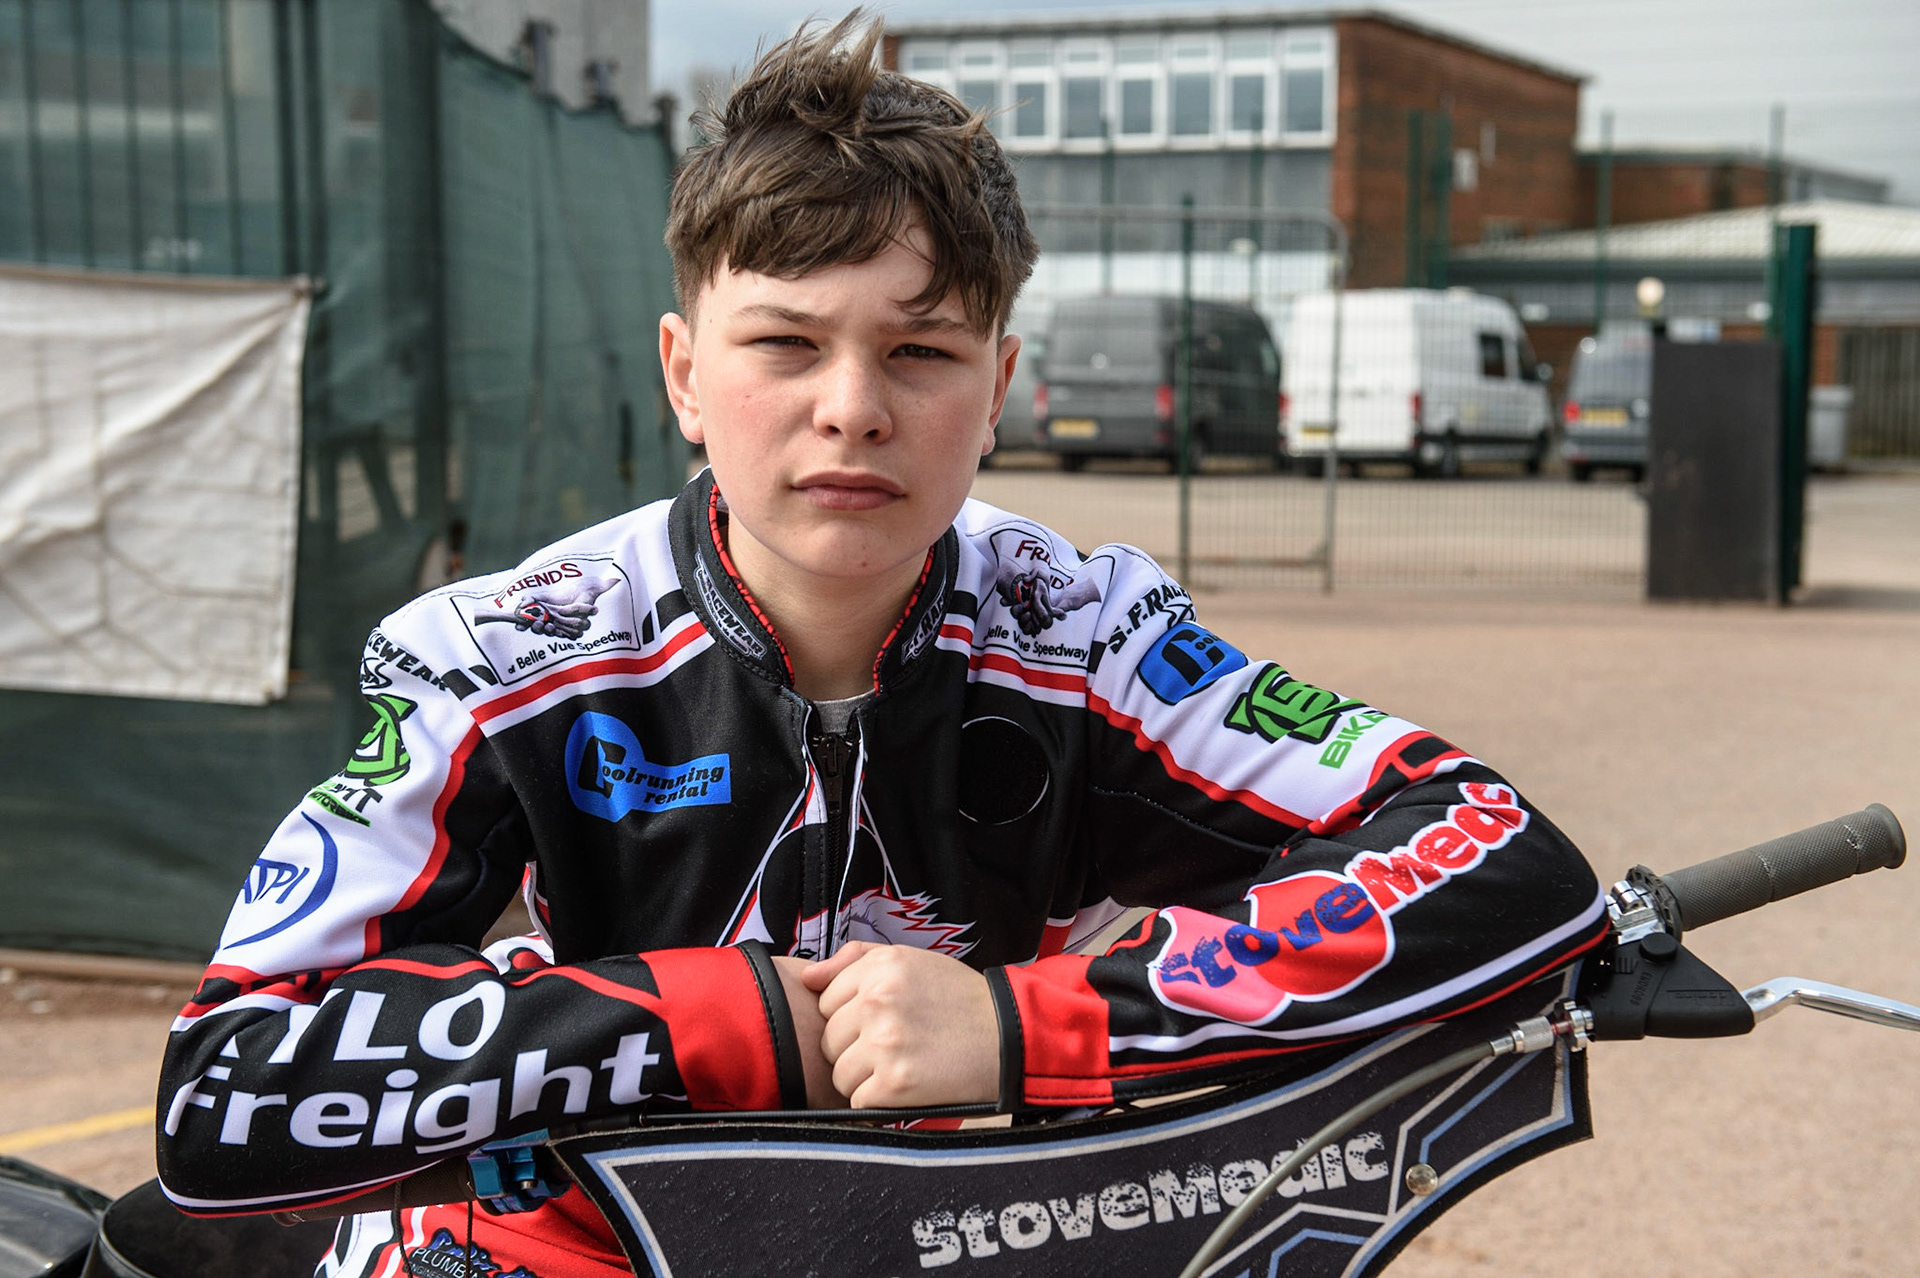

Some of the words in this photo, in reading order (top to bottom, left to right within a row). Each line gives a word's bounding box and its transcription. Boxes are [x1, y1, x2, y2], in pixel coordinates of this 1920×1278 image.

[494, 563, 583, 608] FRIENDS
[516, 649, 547, 670] Belle
[547, 642, 576, 655] Vue
[577, 630, 632, 652] Speedway
[1013, 630, 1031, 652] Vue
[1032, 641, 1089, 662] Speedway
[577, 735, 725, 799] Coolrunning
[643, 782, 709, 805] rental
[164, 1032, 660, 1154] Freight
